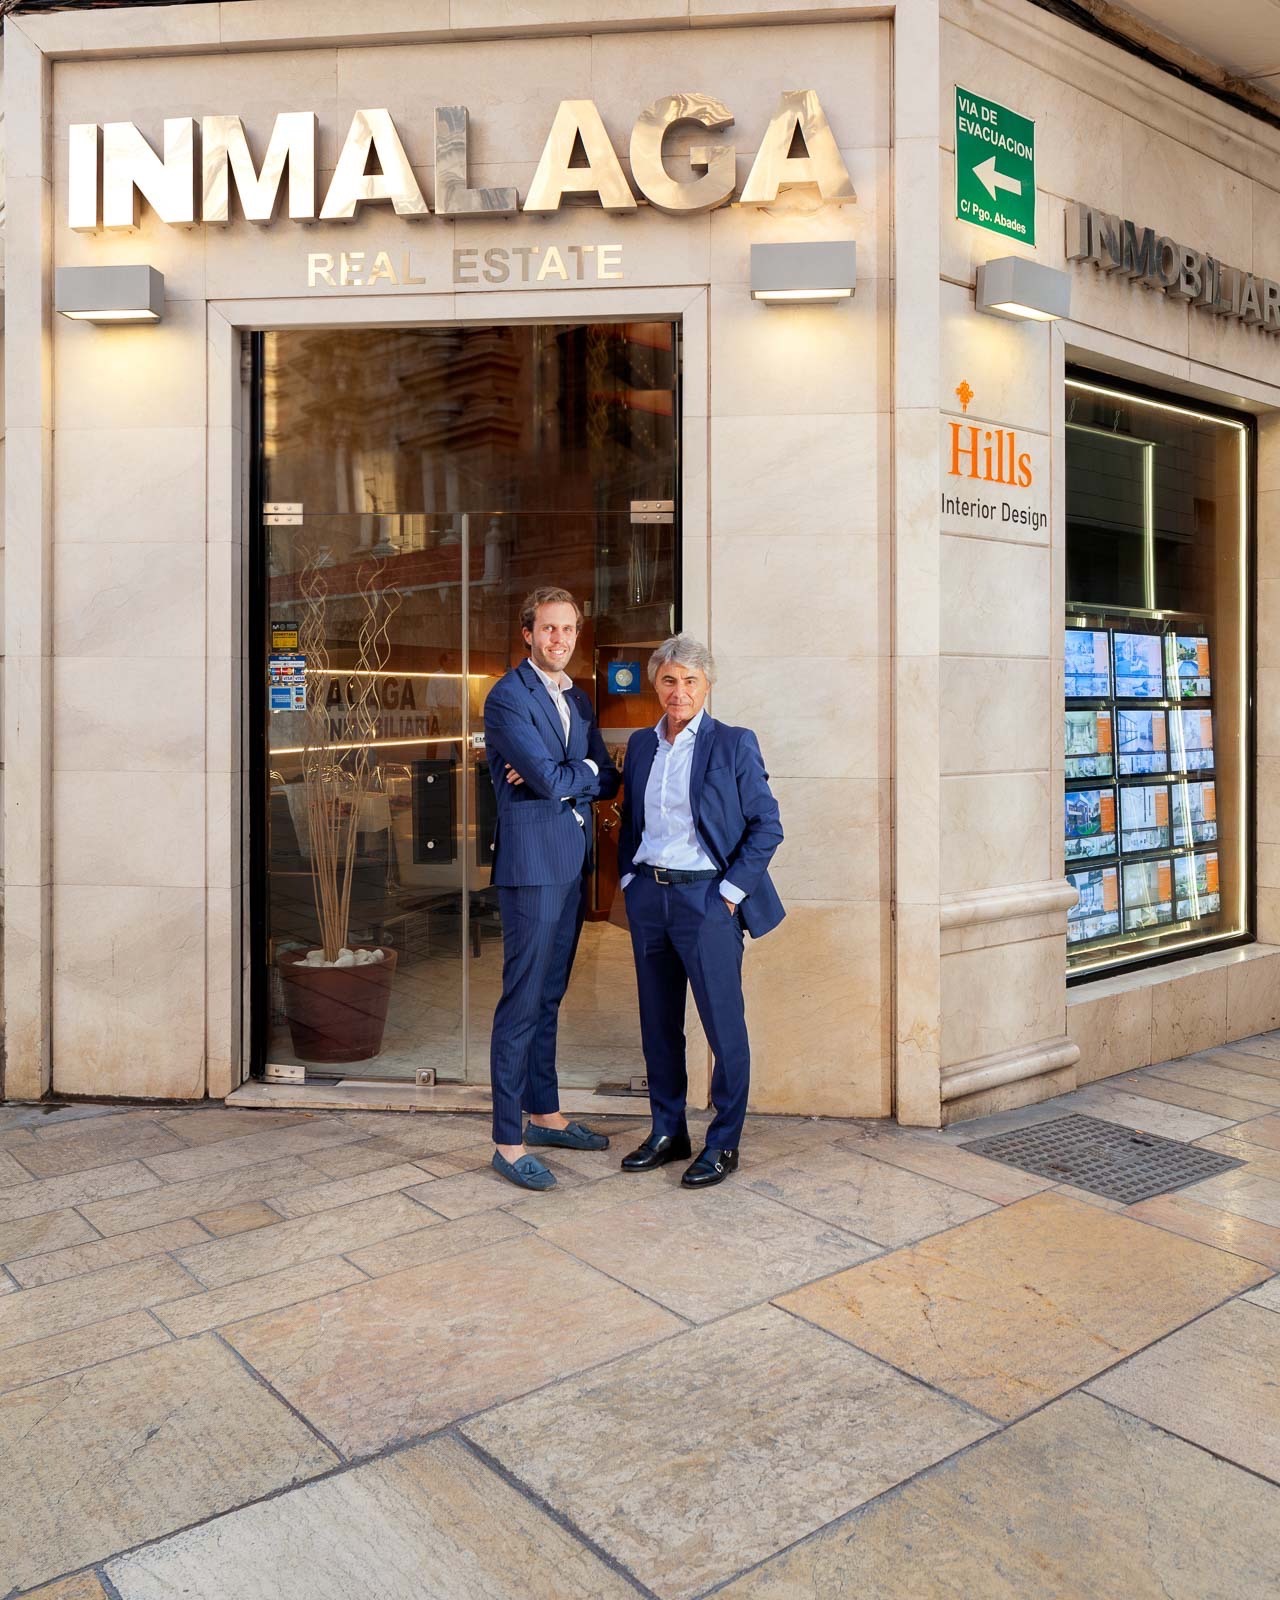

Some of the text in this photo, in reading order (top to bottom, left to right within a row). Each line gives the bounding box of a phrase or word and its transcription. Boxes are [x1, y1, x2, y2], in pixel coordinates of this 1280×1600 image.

[958, 95, 998, 126] VIA DE
[958, 116, 1033, 161] EVACUACION
[67, 89, 857, 233] INMALAGA
[972, 204, 993, 223] Pgo.
[994, 212, 1026, 235] Abades
[307, 244, 624, 288] REAL ESTATE
[947, 422, 1032, 488] Hills
[941, 493, 1048, 531] Interior Design
